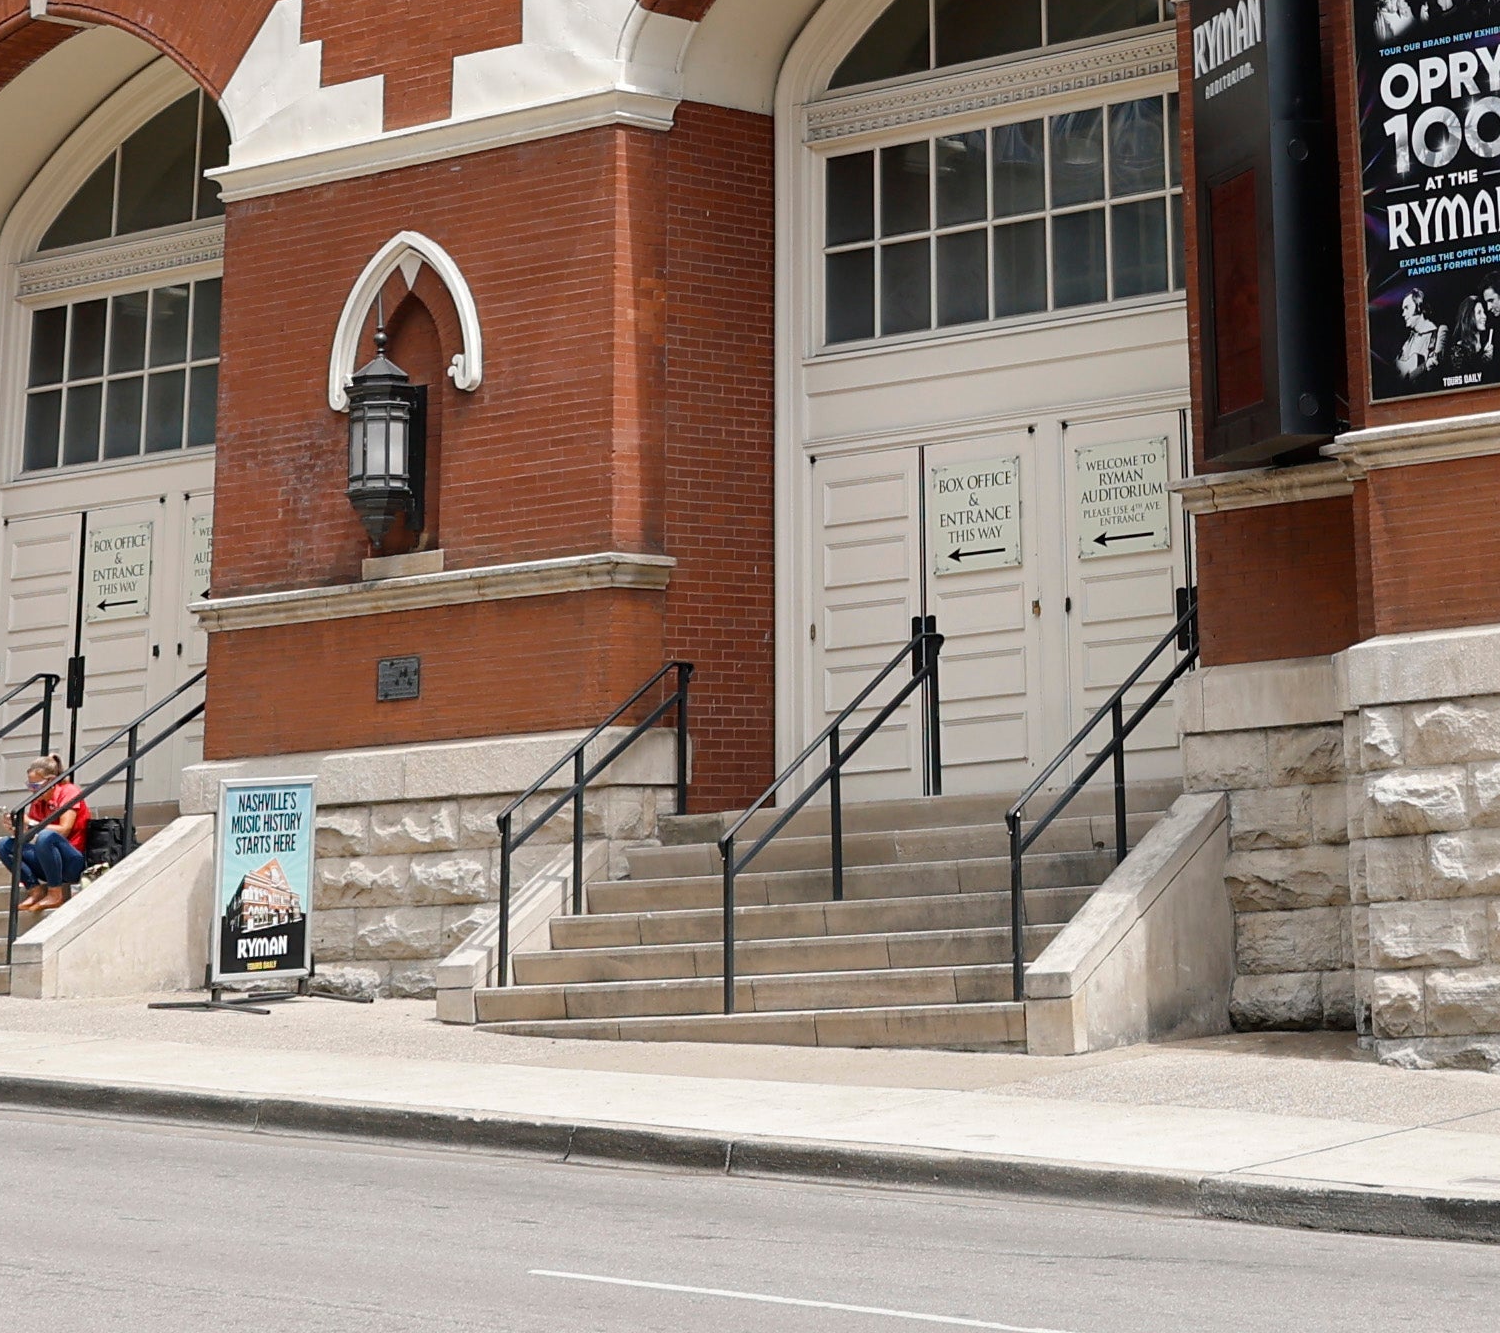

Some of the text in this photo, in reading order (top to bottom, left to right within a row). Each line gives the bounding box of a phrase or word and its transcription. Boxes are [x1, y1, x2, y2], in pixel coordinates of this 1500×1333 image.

[1379, 47, 1401, 57] TOUR
[1403, 42, 1421, 53] OUR
[1422, 37, 1451, 49] BRAND
[1453, 32, 1472, 42] NEW
[1425, 169, 1478, 191] AT THE
[1400, 255, 1436, 268] EXPLORE
[1438, 251, 1455, 261] THE
[1456, 246, 1487, 258] OPRY'S
[1408, 264, 1442, 276] FAMOUS
[1444, 258, 1478, 271] FORMER
[1086, 453, 1156, 471] WELCOME TO
[939, 471, 1011, 493] BOX OFFICE
[1099, 468, 1143, 486] RYMAN
[969, 492, 979, 506] &
[1081, 482, 1163, 504] AUDITORIUM
[940, 505, 1011, 527] ENTRANCE
[1083, 507, 1111, 519] PLEASE
[1113, 505, 1128, 515] USE
[1100, 513, 1145, 526] ENTRANCE
[94, 534, 146, 552] BOX OFFICE
[948, 525, 1002, 543] THIS WAY
[114, 552, 122, 564] &
[93, 564, 144, 582] ENTRANCE
[99, 581, 137, 596] THIS WAY
[238, 791, 297, 813] NASHVILLE'S
[231, 812, 302, 834] MUSIC HISTORY
[235, 833, 296, 855] STARTS HERE
[237, 935, 288, 959] RYMAN
